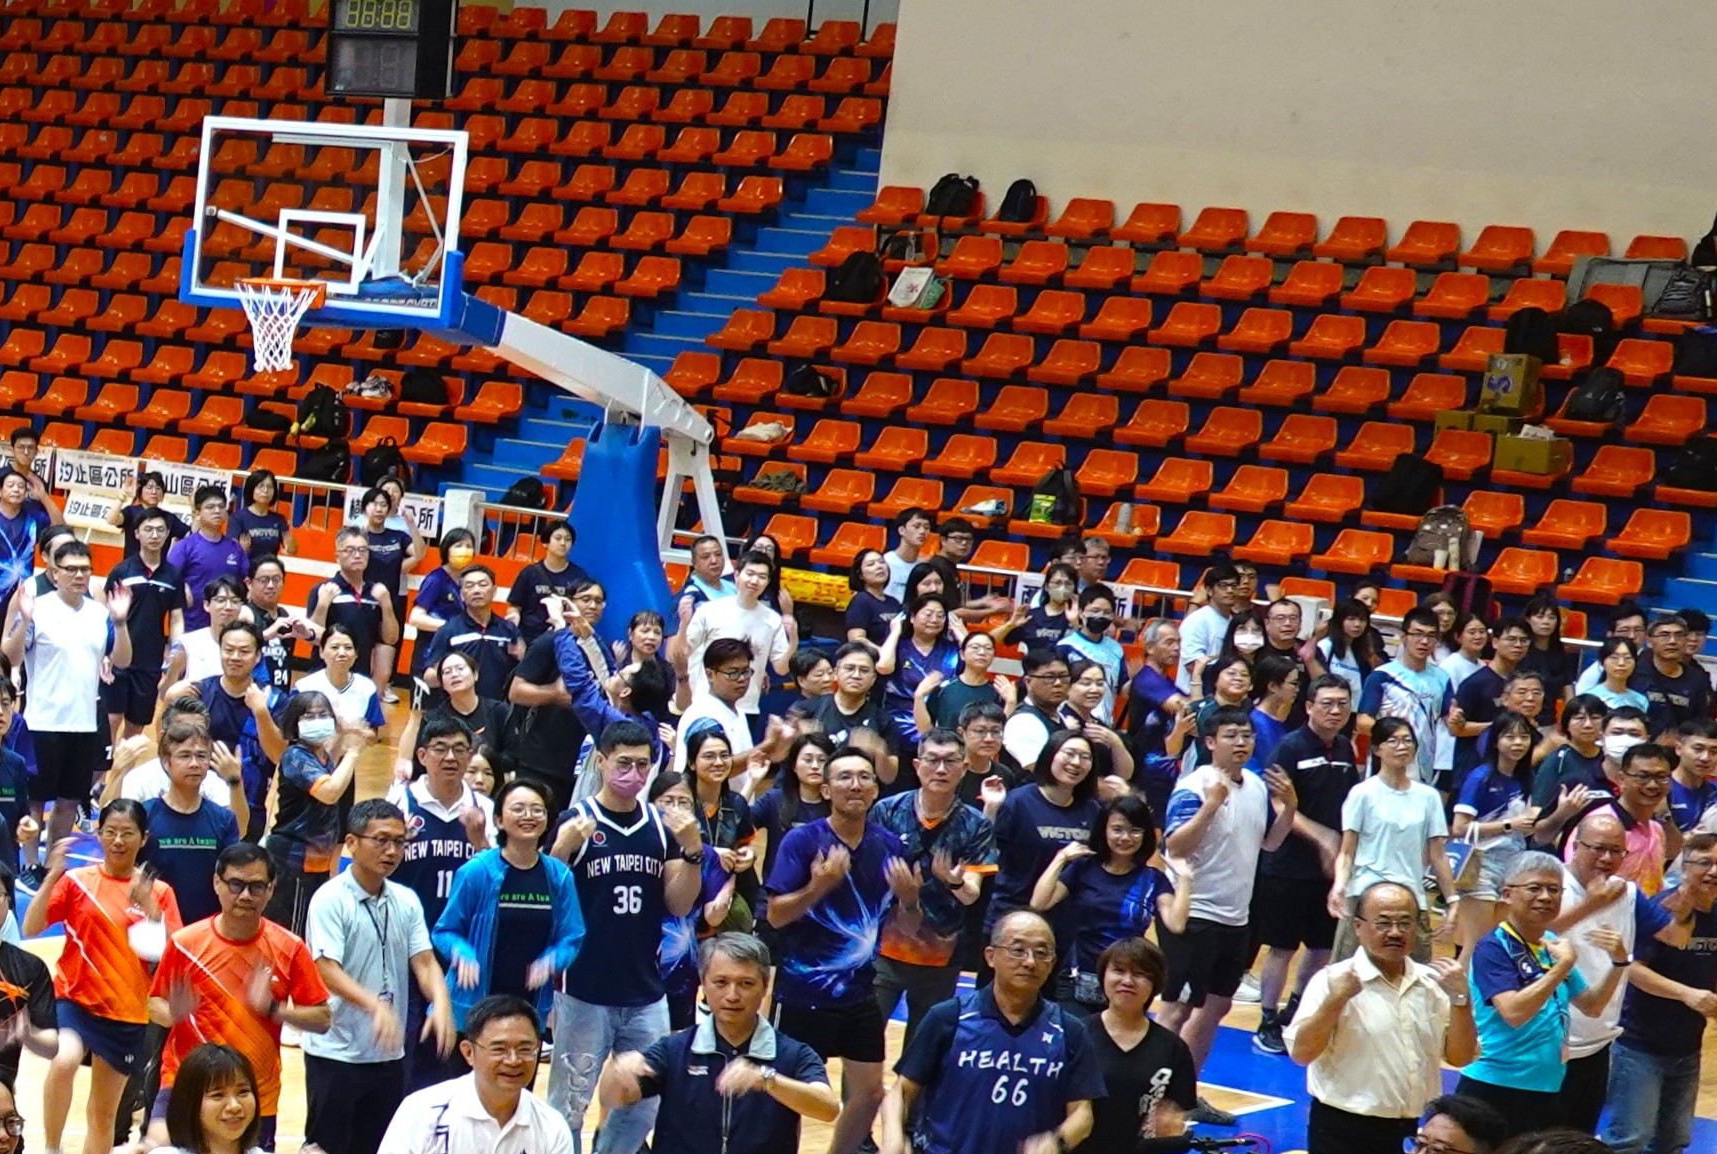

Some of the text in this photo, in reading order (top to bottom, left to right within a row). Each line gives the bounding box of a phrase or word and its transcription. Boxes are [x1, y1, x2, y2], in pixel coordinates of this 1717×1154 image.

[273, 669, 288, 685] 24
[174, 838, 187, 846] are
[405, 842, 428, 861] NEW
[432, 840, 463, 857] TAIPEI
[587, 855, 663, 878] NEW TAIPEI CITY
[437, 869, 453, 898] 11
[512, 893, 525, 901] are
[613, 885, 642, 914] 36
[958, 1051, 1064, 1078] HEALTH
[991, 1076, 1029, 1107] 66
